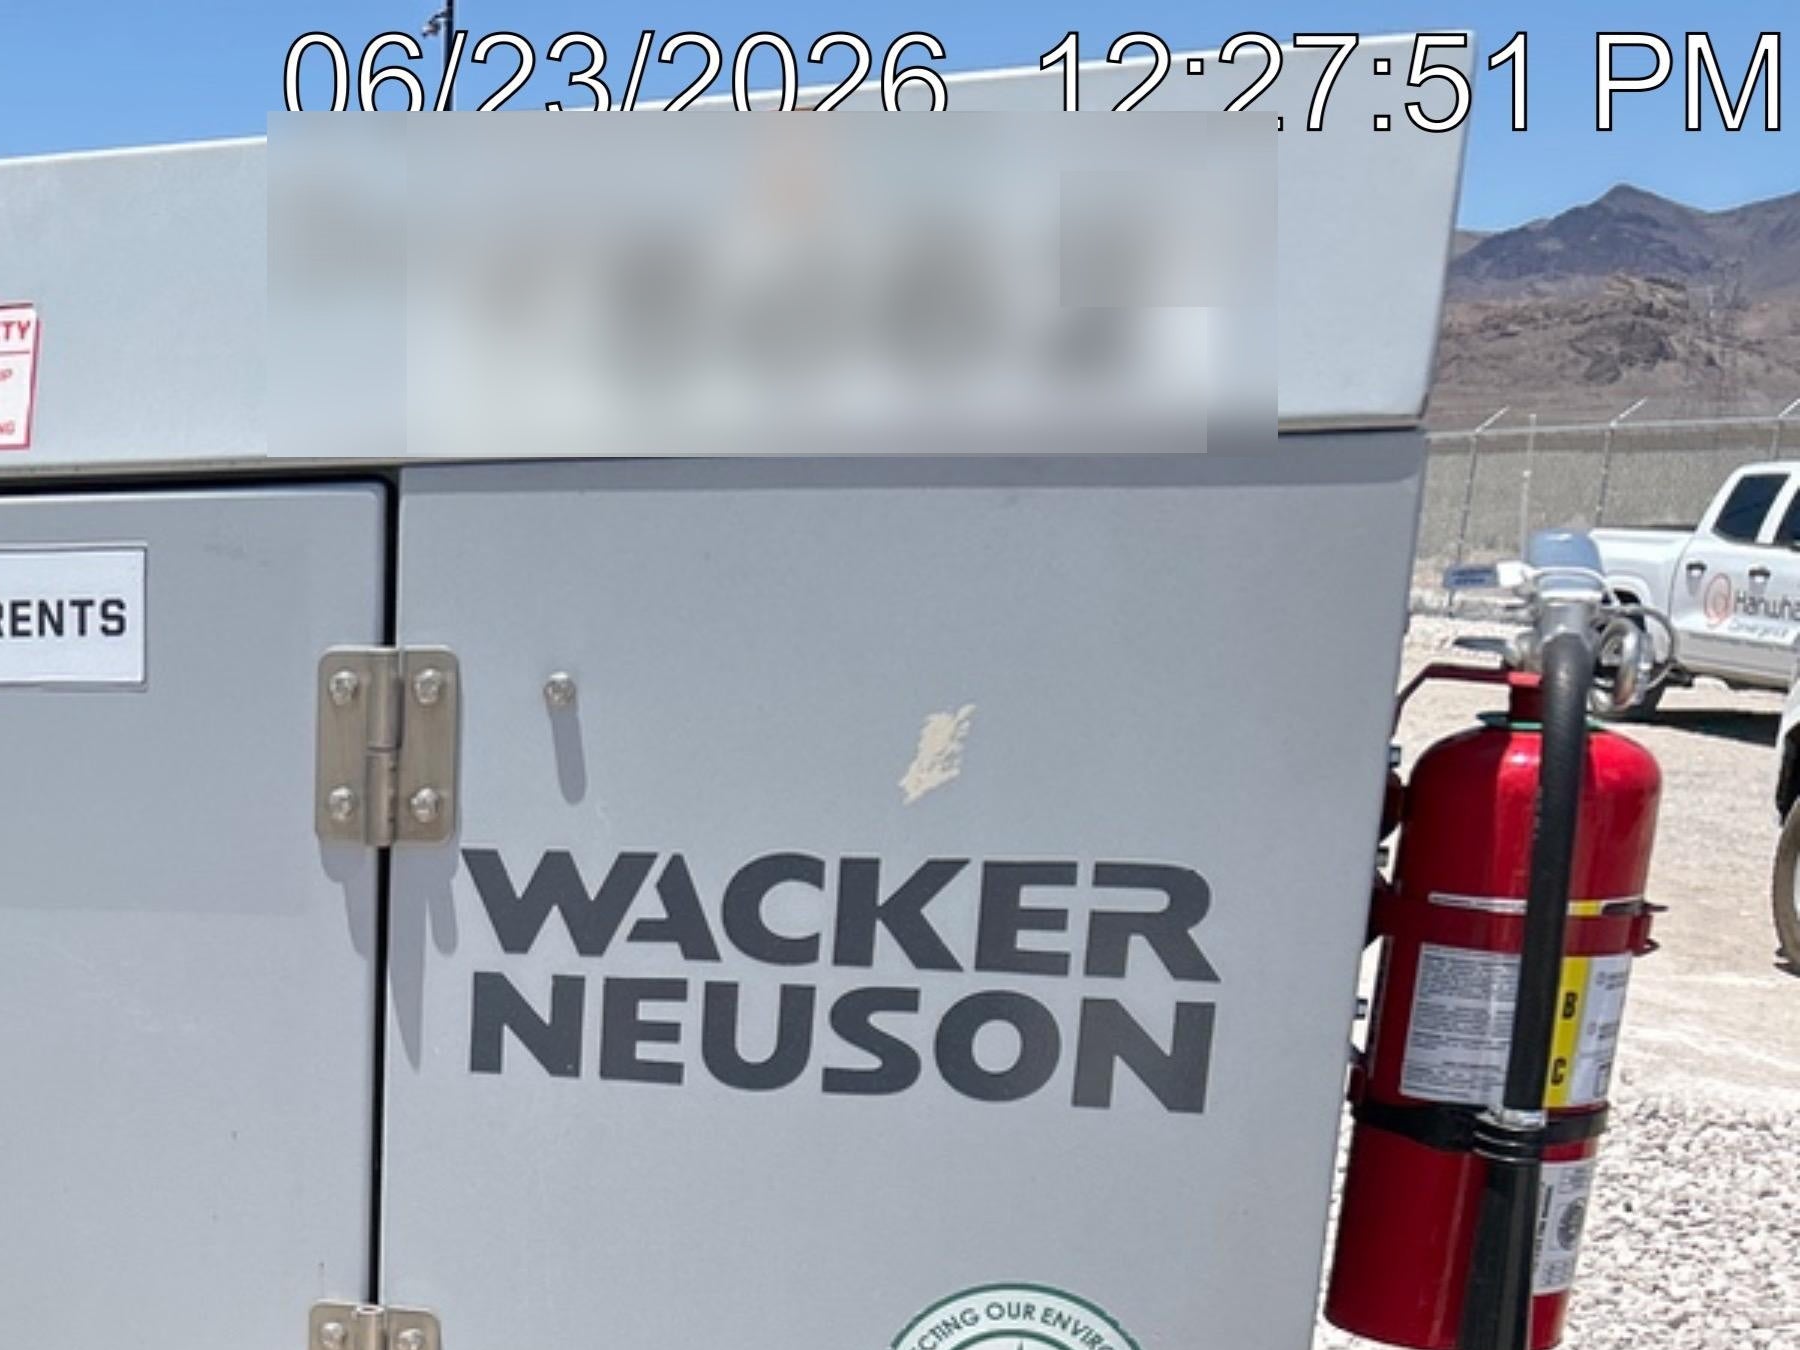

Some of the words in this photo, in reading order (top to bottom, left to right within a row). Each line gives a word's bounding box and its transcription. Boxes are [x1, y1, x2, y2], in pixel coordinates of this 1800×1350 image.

[461, 848, 1222, 984] WACKER
[1562, 992, 1579, 1019] B
[468, 971, 1217, 1114] NEUSON
[1551, 1057, 1567, 1086] C
[985, 1301, 1036, 1321] OUR
